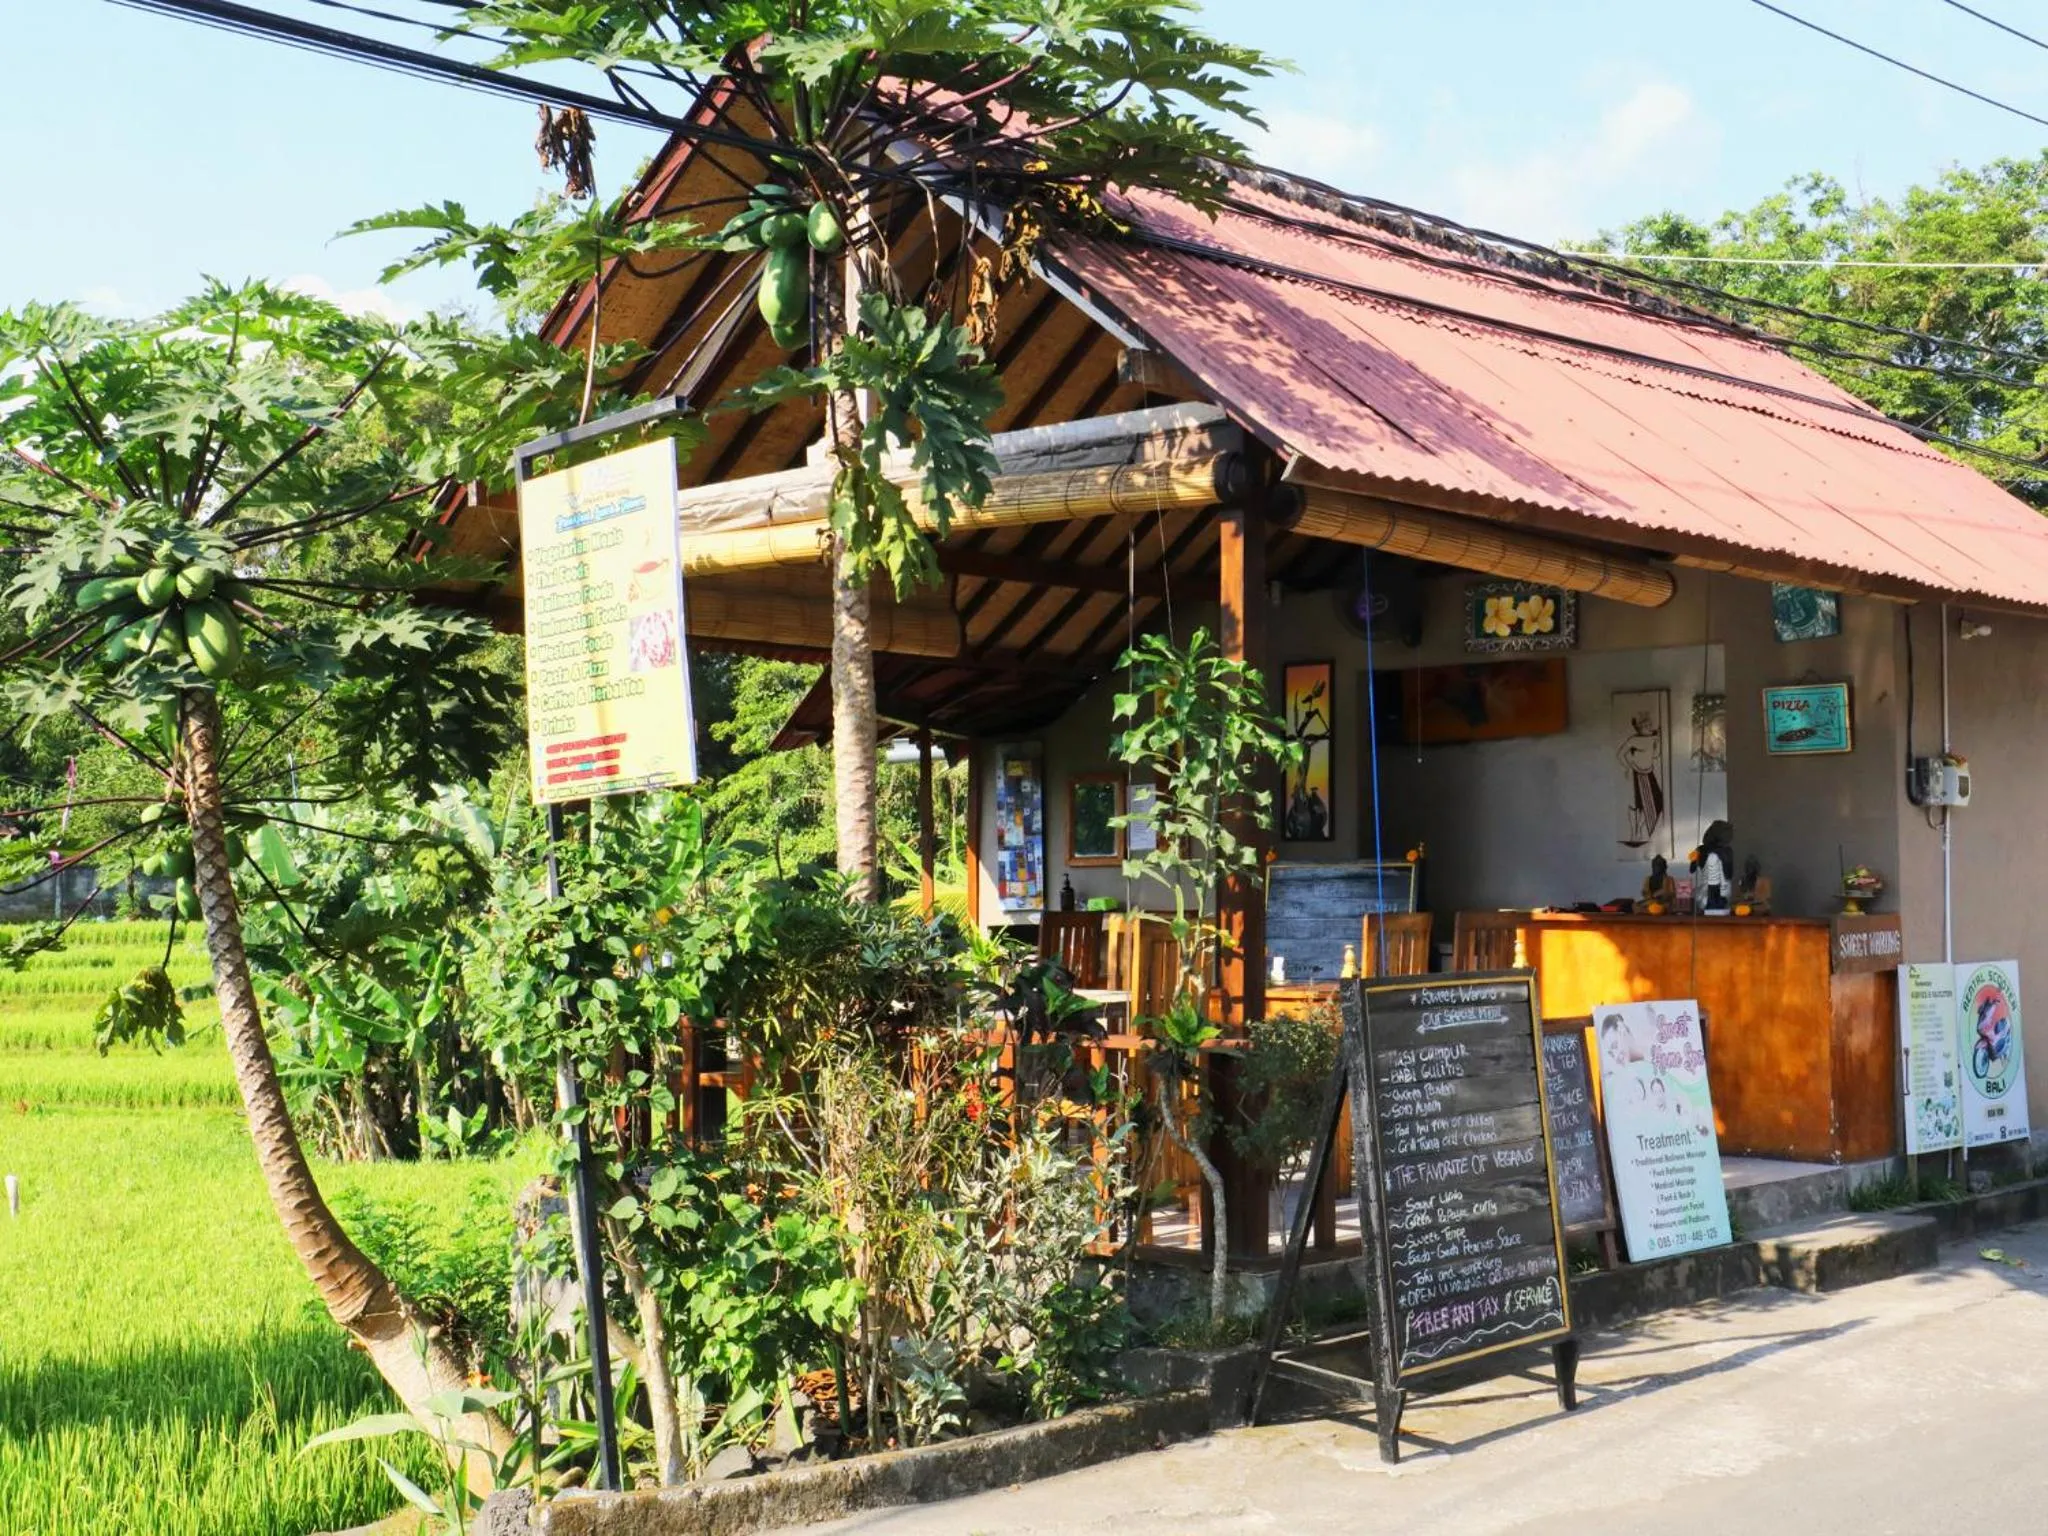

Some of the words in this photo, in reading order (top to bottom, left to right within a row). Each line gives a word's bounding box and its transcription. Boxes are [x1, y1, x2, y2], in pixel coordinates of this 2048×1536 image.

[1772, 699, 1810, 711] PIZZA
[1840, 933, 1868, 957] SWEET
[1421, 987, 1457, 1005] Sweet
[1963, 971, 1986, 1012] RENTAL
[1986, 1079, 2006, 1094] BALI
[1637, 1130, 1692, 1151] Treatment
[1392, 1163, 1418, 1189] THE
[1417, 1157, 1469, 1184] FAVORITE
[1471, 1154, 1488, 1175] OF
[1412, 1308, 1449, 1337] FREE
[1451, 1301, 1475, 1329] ANY
[1476, 1295, 1500, 1320] TAX
